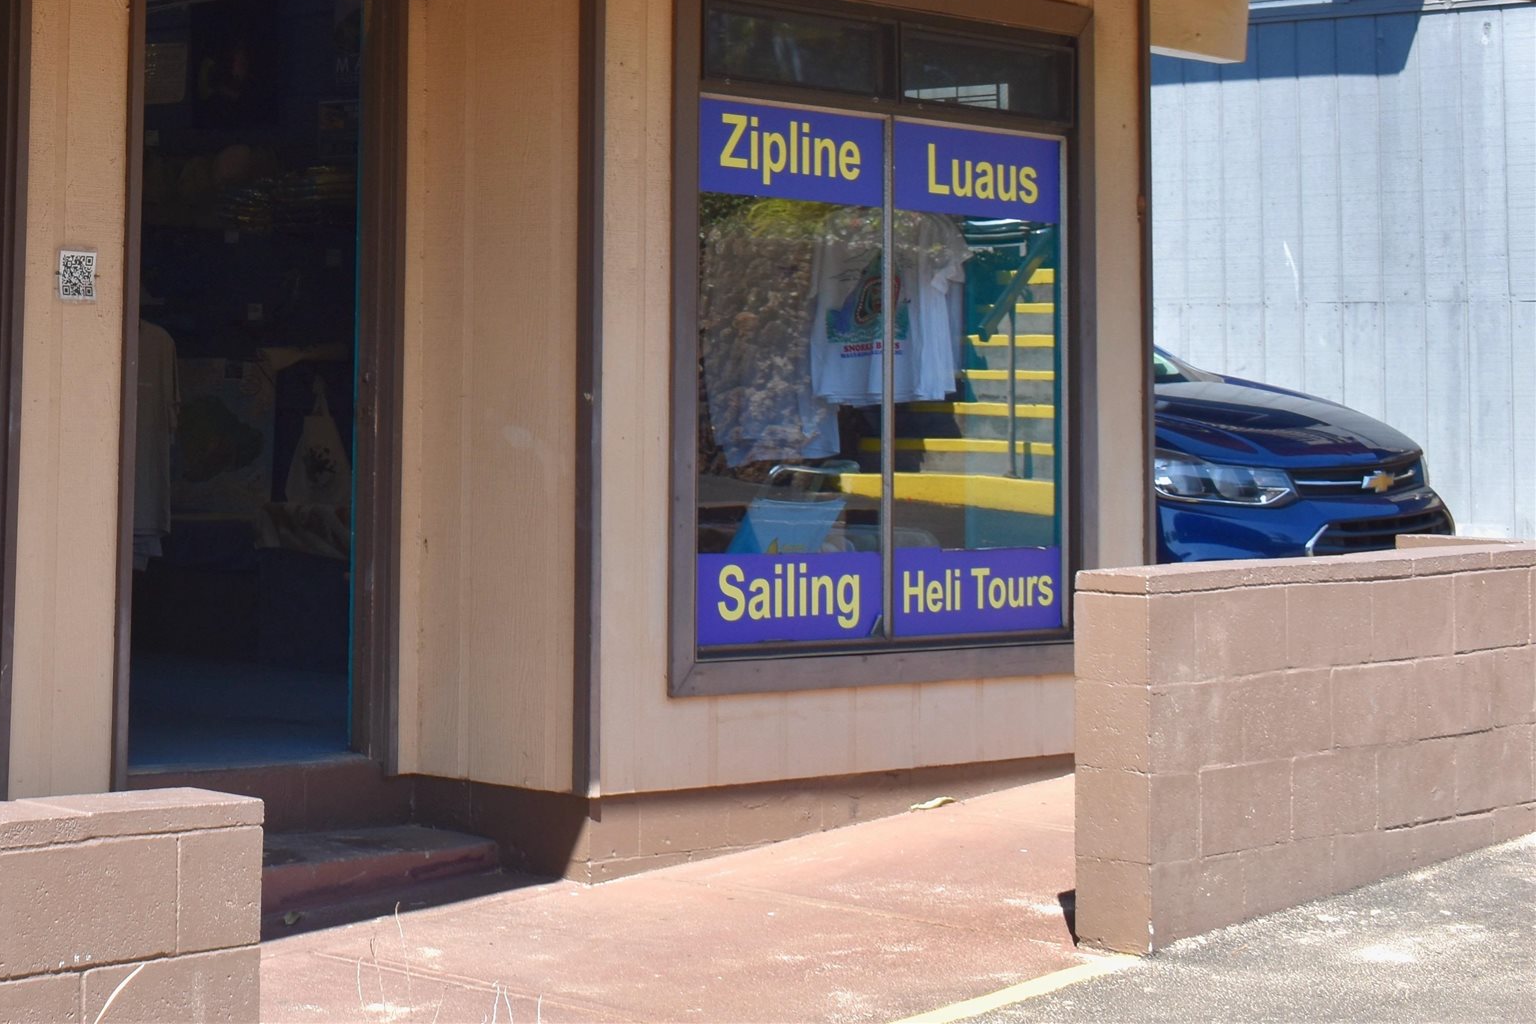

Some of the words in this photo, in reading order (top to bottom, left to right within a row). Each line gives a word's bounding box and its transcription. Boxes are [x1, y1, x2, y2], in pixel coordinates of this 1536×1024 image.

[719, 112, 862, 185] Zipline
[927, 143, 1039, 204] Luaus
[718, 562, 860, 629] Sailing
[903, 569, 961, 614] Heli
[970, 567, 1054, 610] Tours
